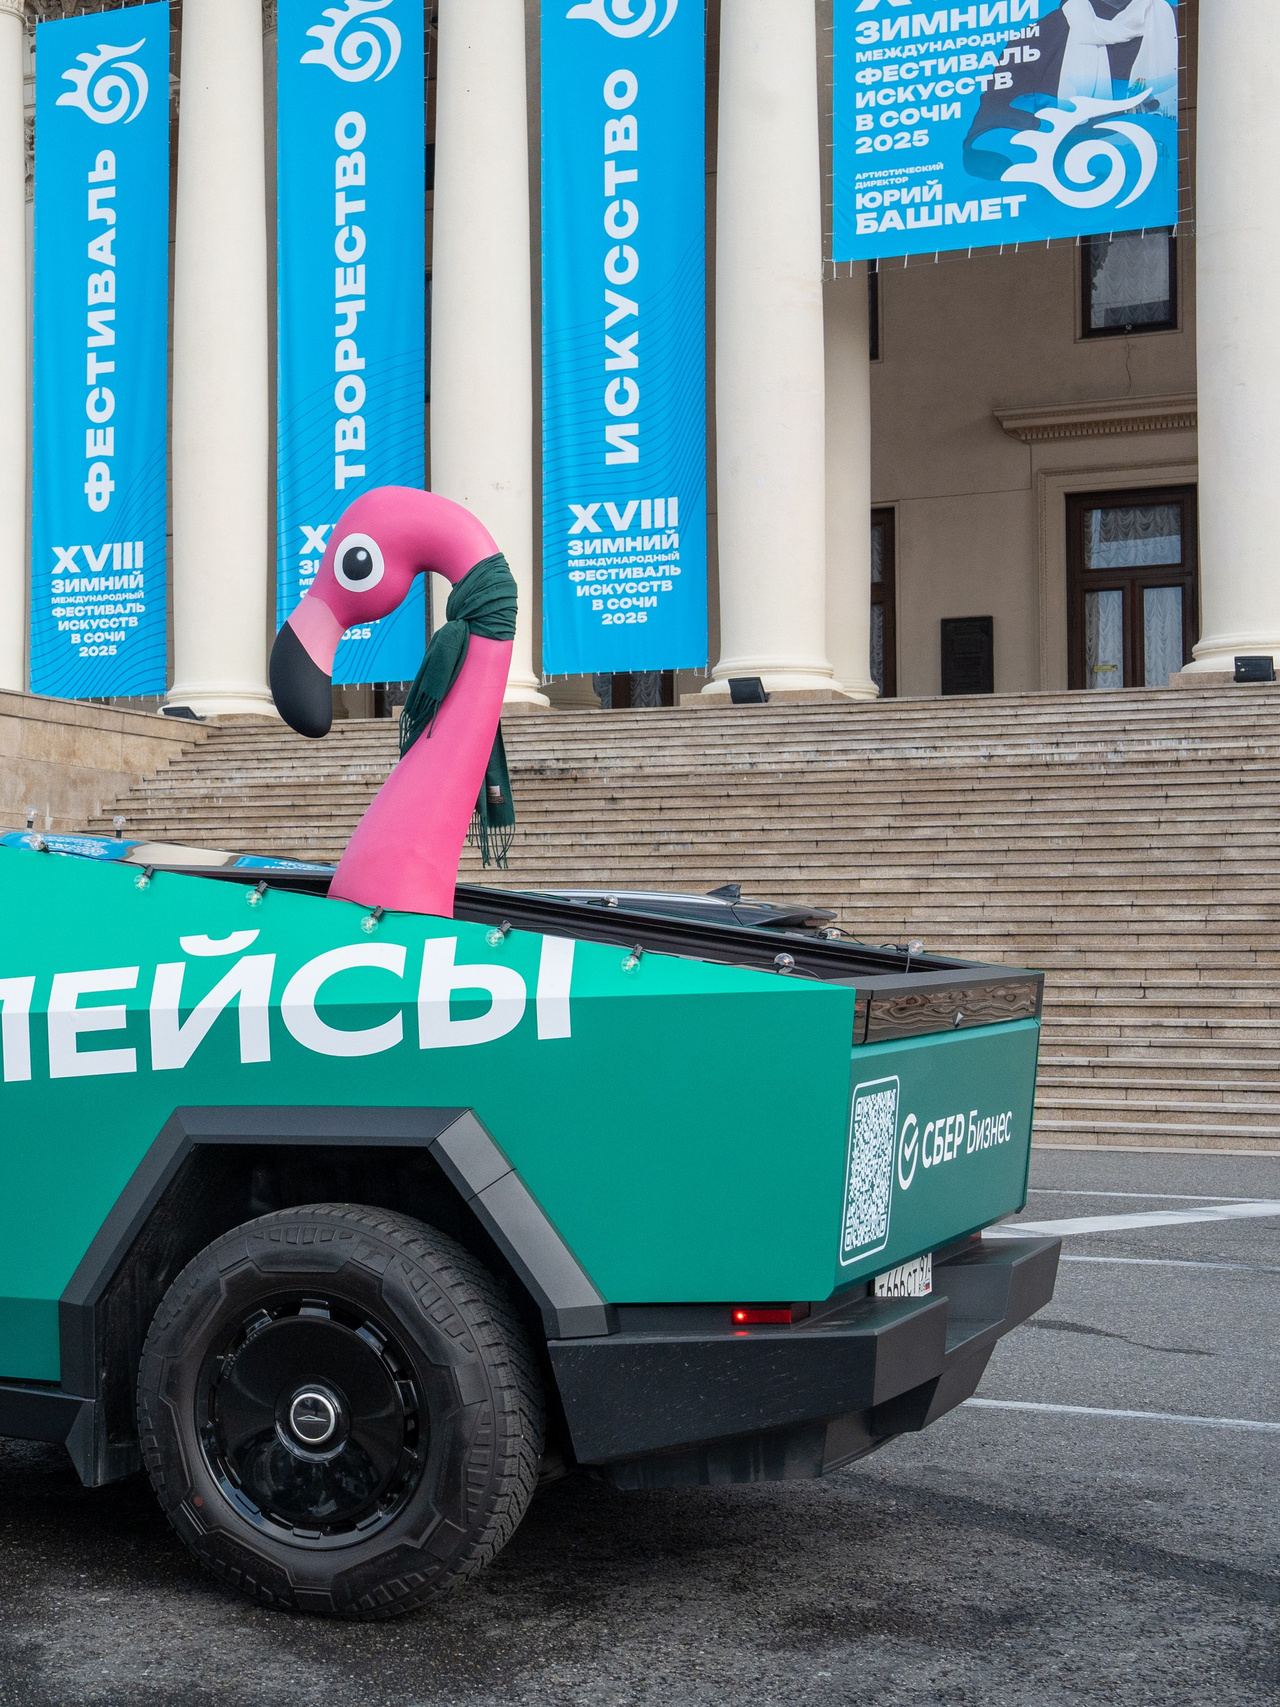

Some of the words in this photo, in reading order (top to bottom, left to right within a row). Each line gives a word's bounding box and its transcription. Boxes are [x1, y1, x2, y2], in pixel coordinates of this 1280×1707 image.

[855, 23, 1040, 63] МЕЖДУНАРОДНЫЙ
[855, 45, 1041, 86] ФЕСТИВАЛЬ
[855, 71, 1013, 109] ИСКУССТВ
[855, 113, 874, 131] В
[879, 102, 961, 126] СОЧИ
[855, 129, 929, 155] 2025
[855, 162, 944, 180] АРТИСТИЧЕСКИЙ
[855, 176, 909, 190] ДИРЕКТОР
[855, 179, 943, 210] ЮРИЙ
[855, 194, 1027, 235] БАШМЕТ
[603, 69, 640, 465] ИСКУССТВО
[334, 111, 367, 490] ТВОРЧЕСТВО
[84, 149, 116, 512] ФЕСТИВАЛЬ
[567, 496, 679, 534] XVIII
[567, 529, 679, 556] ЗИМНИЙ
[50, 540, 144, 574] XVIII
[567, 551, 680, 567] МЕЖДУНАРОДНЫЙ
[50, 570, 144, 594] ЗИМНИЙ
[568, 564, 682, 583] ФЕСТИВАЛЬ
[51, 590, 145, 605] МЕЖДУНАРОДНЫЙ
[576, 579, 673, 597] ИСКУССТВ
[51, 602, 146, 618] ФЕСТИВАЛЬ
[591, 599, 604, 611] В
[606, 596, 658, 610] СОЧИ
[58, 616, 139, 631] ИСКУССТВ
[601, 611, 648, 625] 2025
[70, 633, 82, 644] В
[83, 630, 126, 643] СОЧИ
[339, 628, 372, 641] 025
[78, 645, 117, 658] 2025
[921, 1112, 966, 1169] СБЕР
[966, 1109, 1013, 1155] Бизнес
